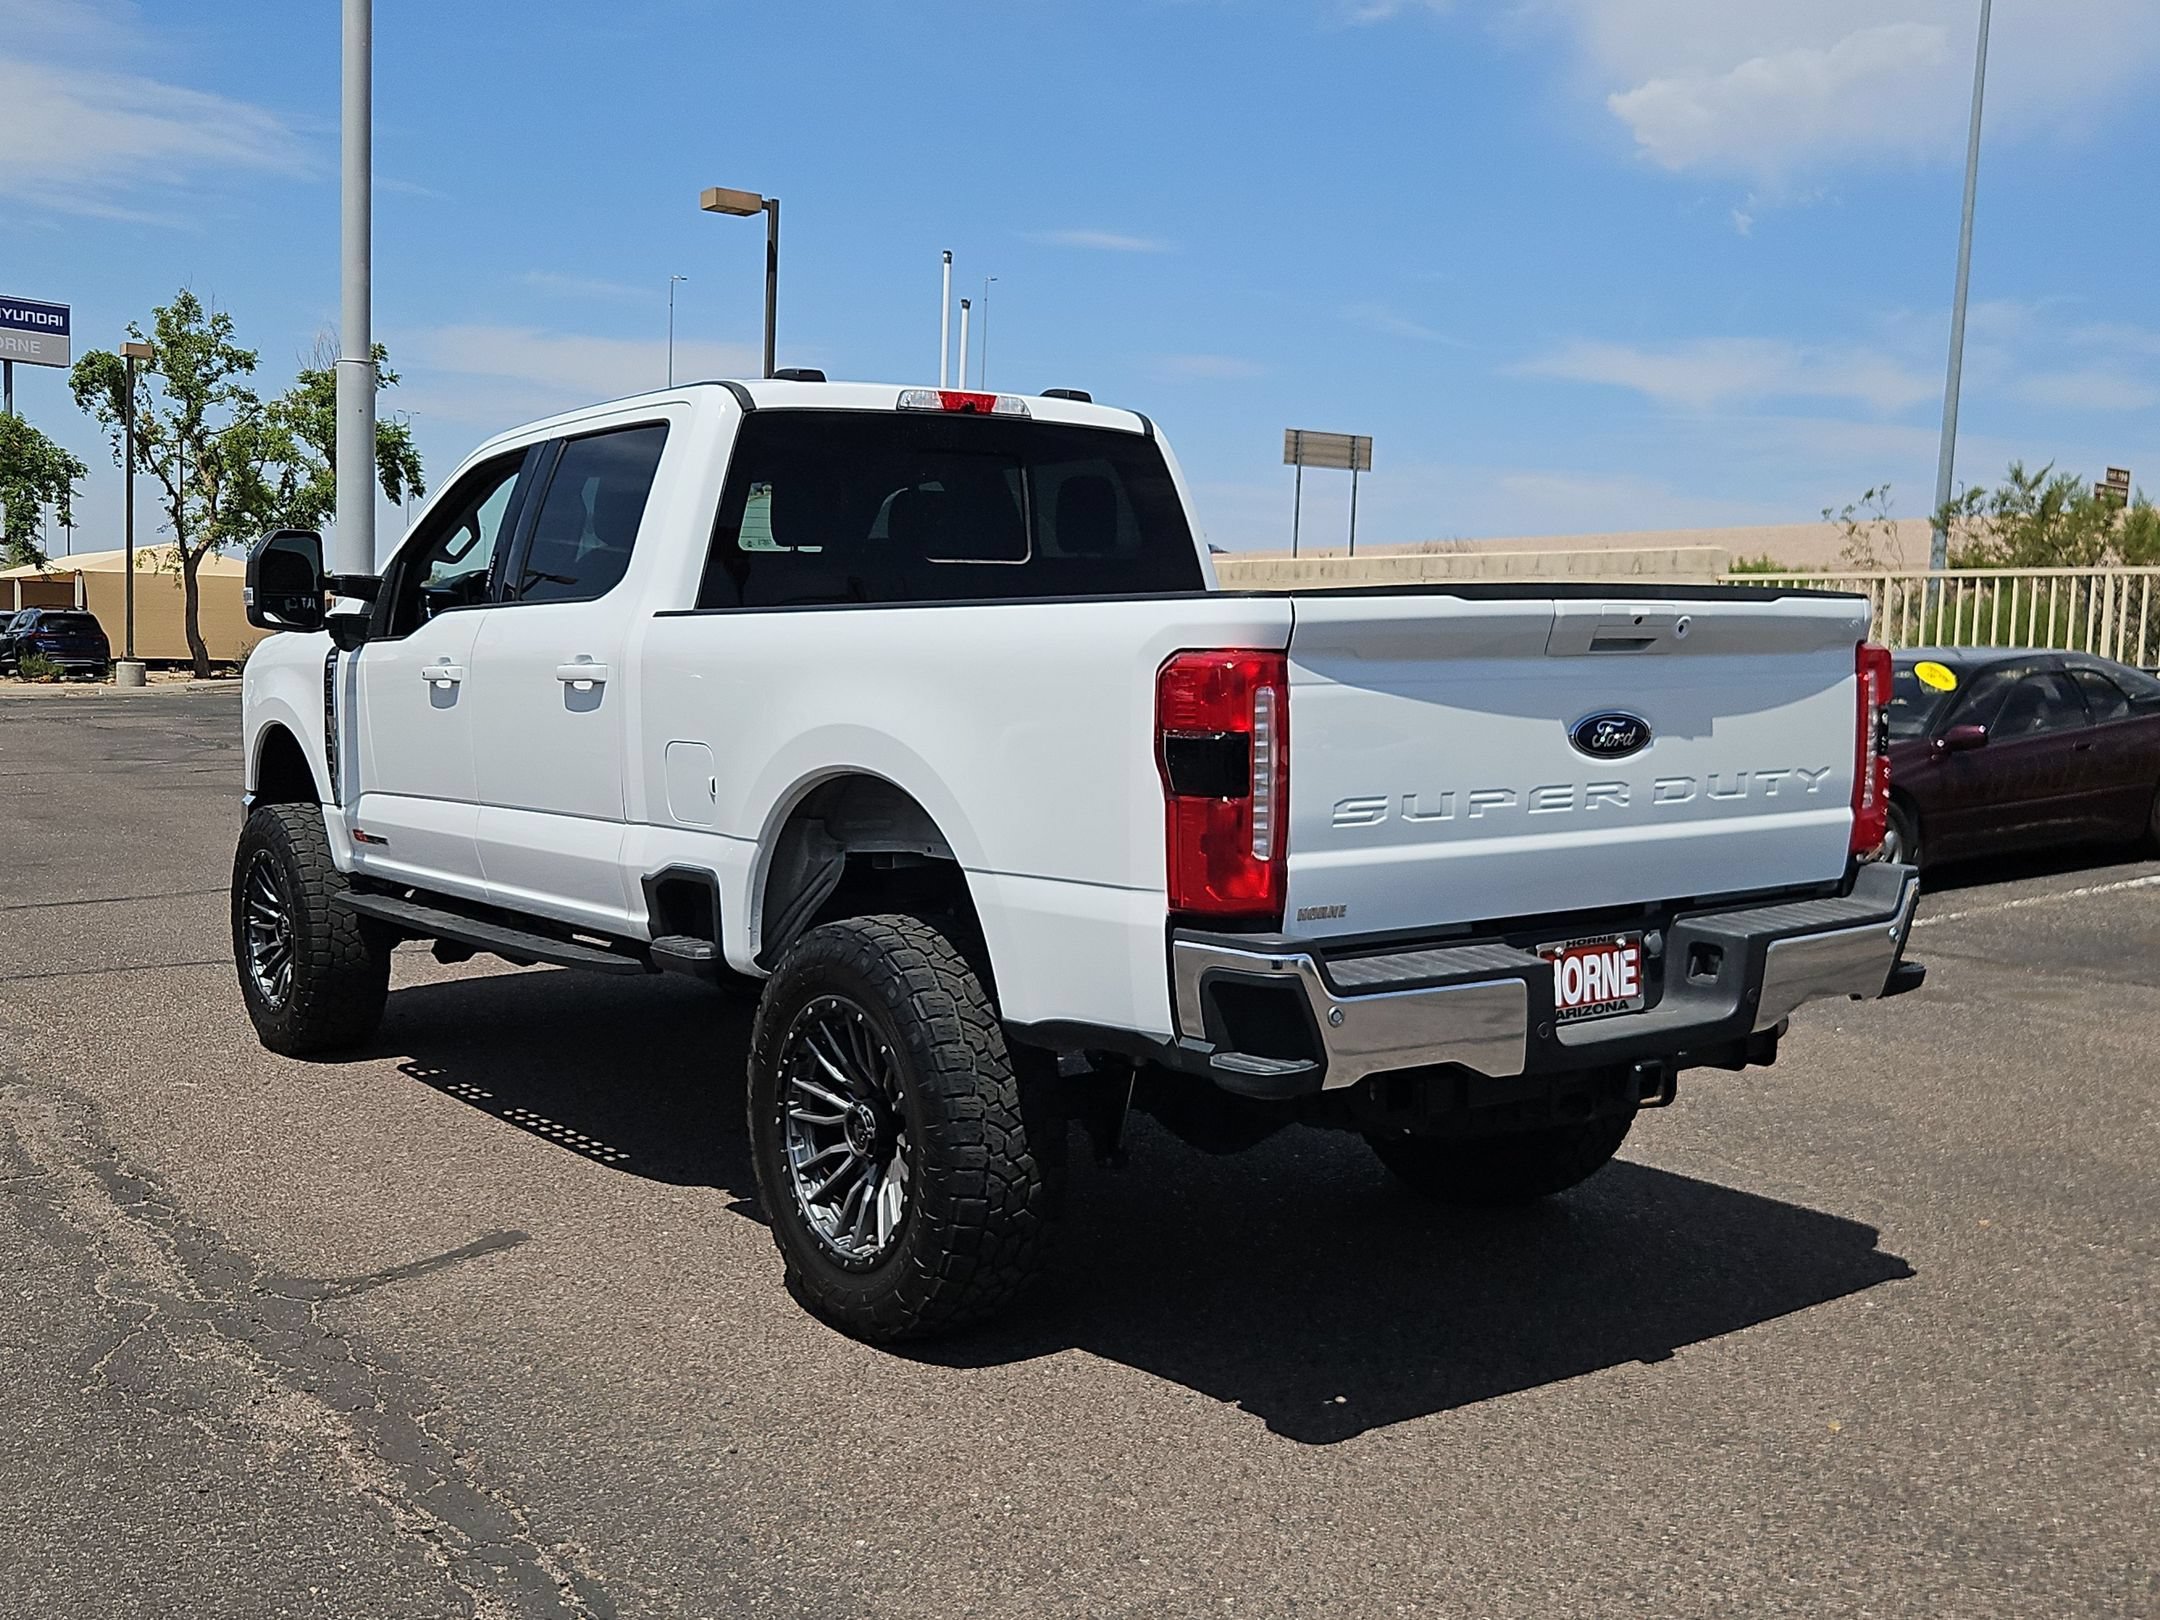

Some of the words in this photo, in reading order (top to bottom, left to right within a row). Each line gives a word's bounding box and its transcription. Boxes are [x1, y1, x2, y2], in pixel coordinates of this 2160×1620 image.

[0, 307, 62, 326] YUNDAI
[1592, 720, 1637, 748] Ford
[1332, 780, 1630, 828] SUPER
[1653, 766, 1831, 805] DUTY
[1566, 935, 1617, 948] HORNE
[1556, 1000, 1629, 1020] ARIZONA
